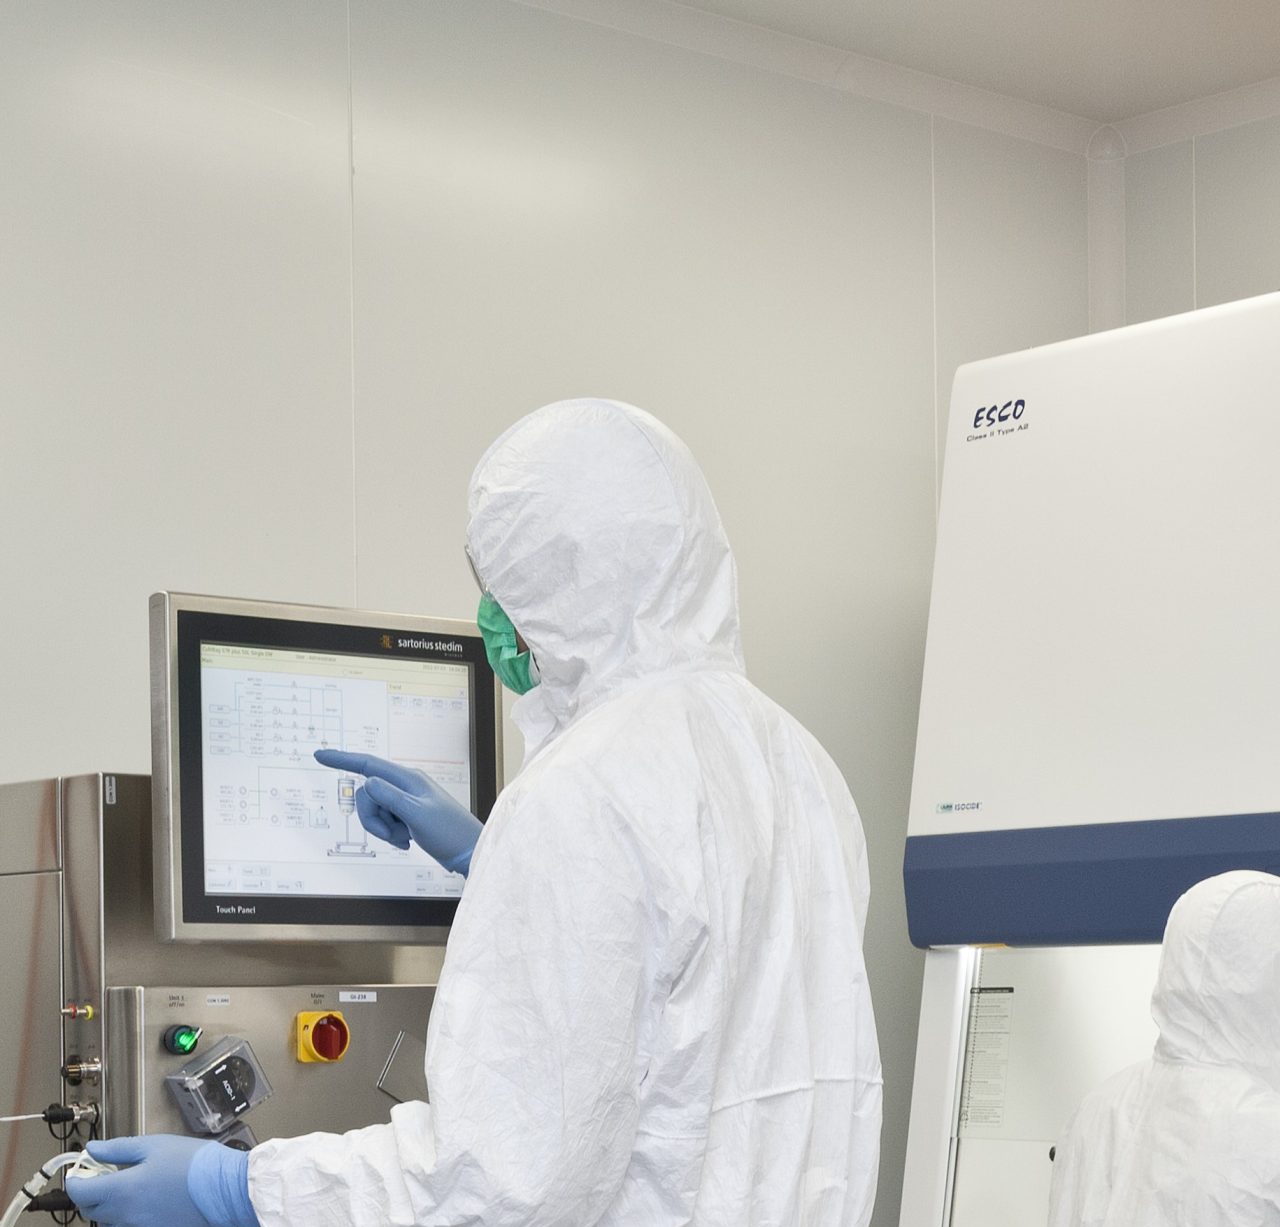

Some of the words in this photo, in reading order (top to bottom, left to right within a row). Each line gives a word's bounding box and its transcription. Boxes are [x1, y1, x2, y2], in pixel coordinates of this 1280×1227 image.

[973, 399, 1025, 428] ESCO
[998, 428, 1015, 436] Type
[398, 638, 434, 650] sartorius
[434, 641, 463, 653] stedim
[216, 905, 236, 914] Touch
[237, 905, 256, 914] Panel
